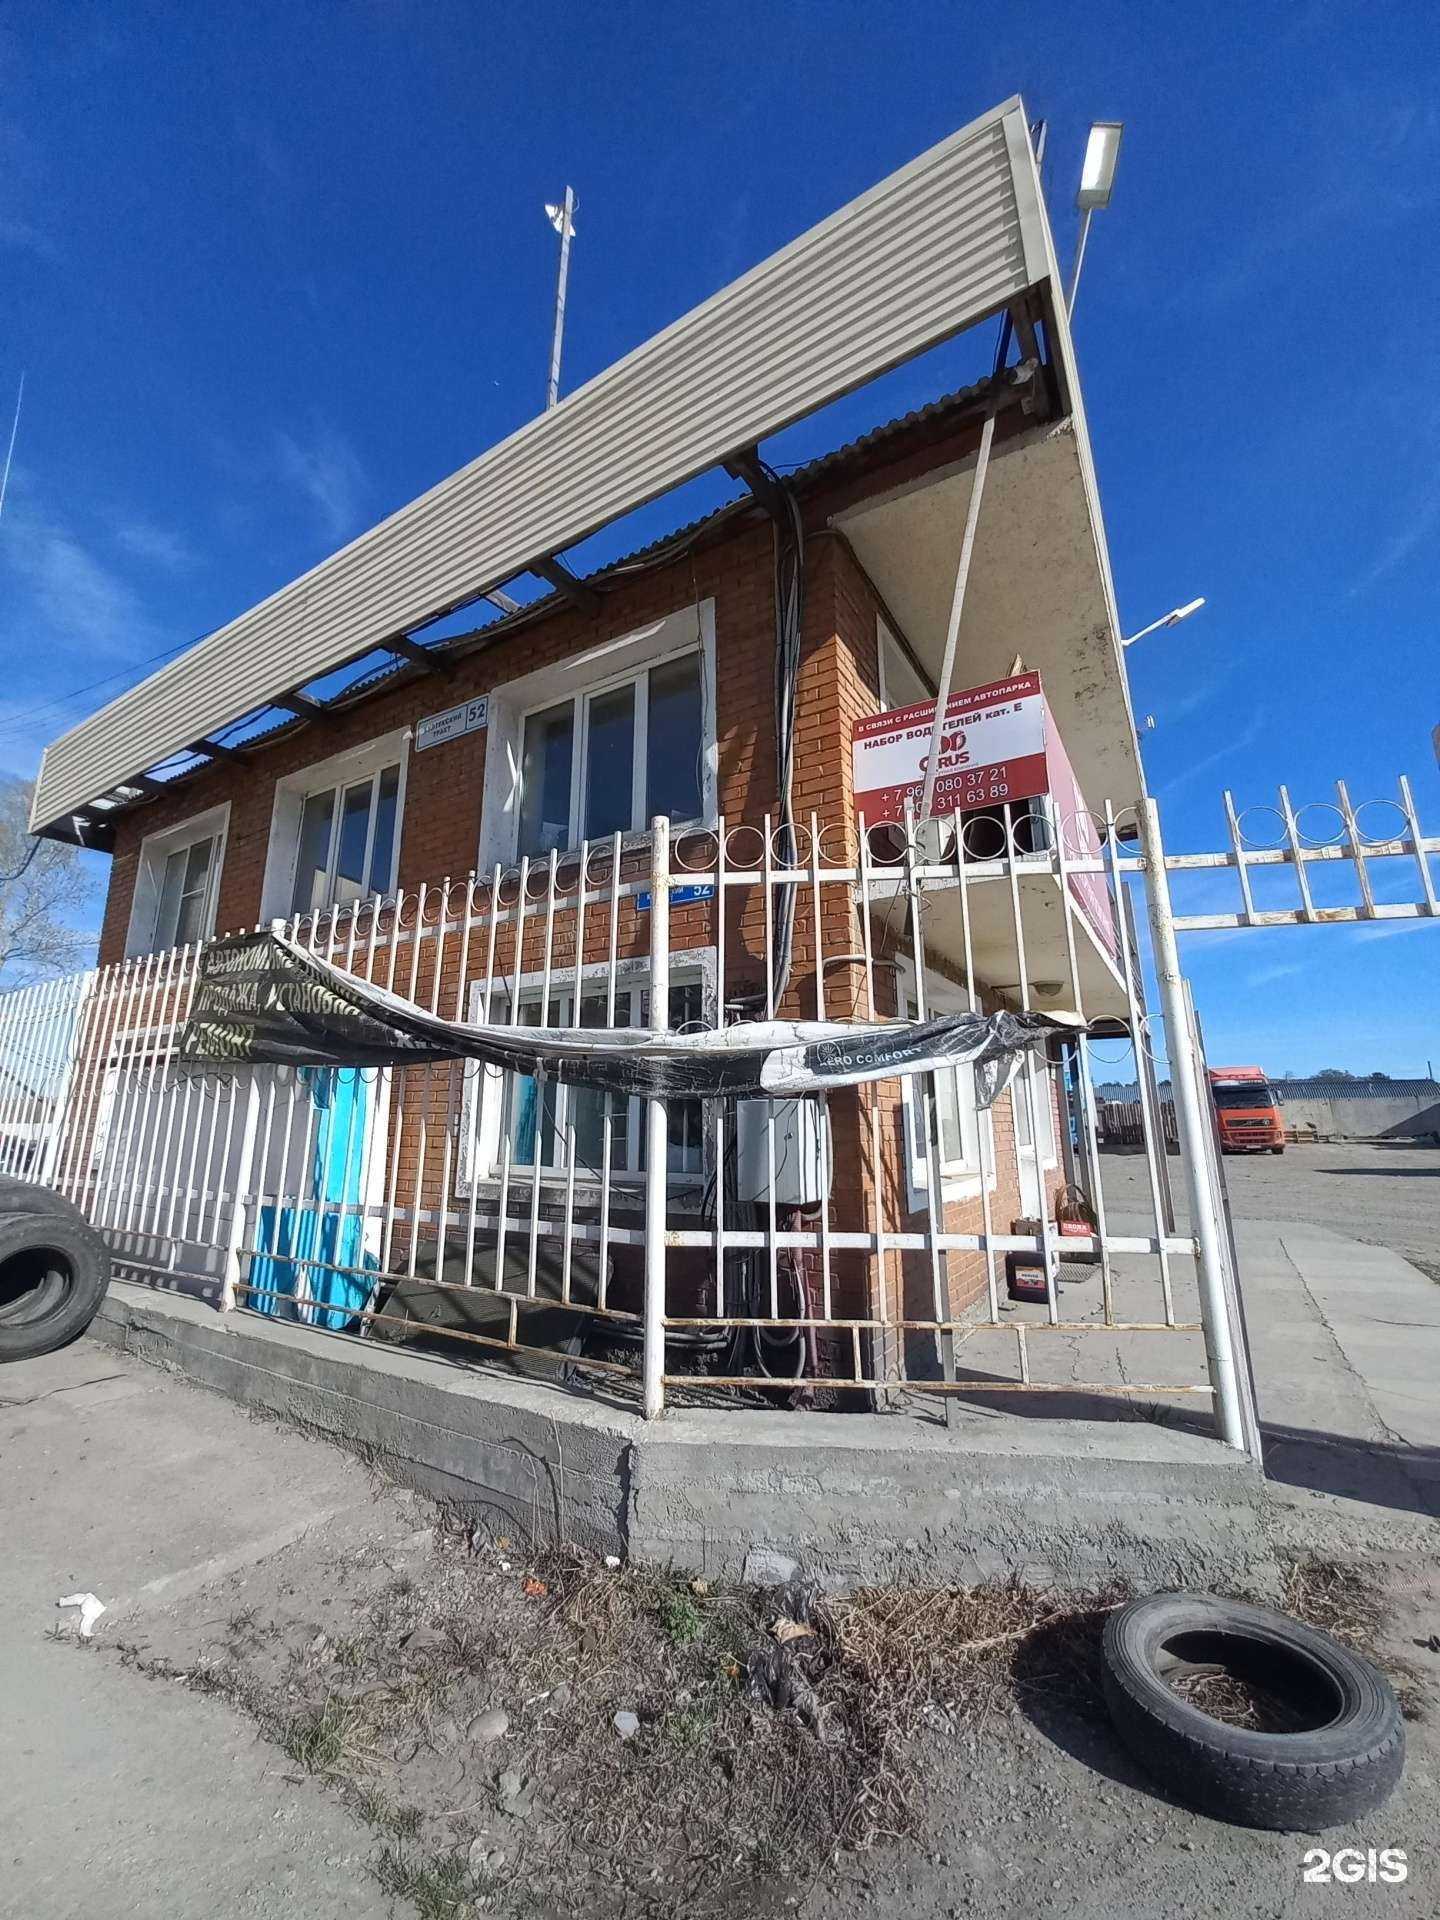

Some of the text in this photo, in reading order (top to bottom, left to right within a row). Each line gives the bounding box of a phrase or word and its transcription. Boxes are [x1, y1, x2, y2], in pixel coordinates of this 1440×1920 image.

[468, 703, 486, 722] 52
[865, 718, 893, 731] СВЯЗИ
[895, 715, 901, 723] С
[973, 681, 1032, 702] АВТОПАРКА
[864, 734, 903, 750] НАБОР
[906, 711, 982, 740] ВОДТЕЛЕЙ
[985, 708, 1010, 720] кат.
[919, 750, 970, 773] CRUS
[894, 789, 902, 801] 7
[906, 784, 924, 798] 96
[936, 776, 962, 793] 080
[966, 771, 985, 786] 37
[989, 766, 1007, 781] 21
[894, 805, 902, 817] 7
[937, 793, 961, 809] 311
[966, 788, 985, 803] 63
[989, 783, 1008, 798] 89
